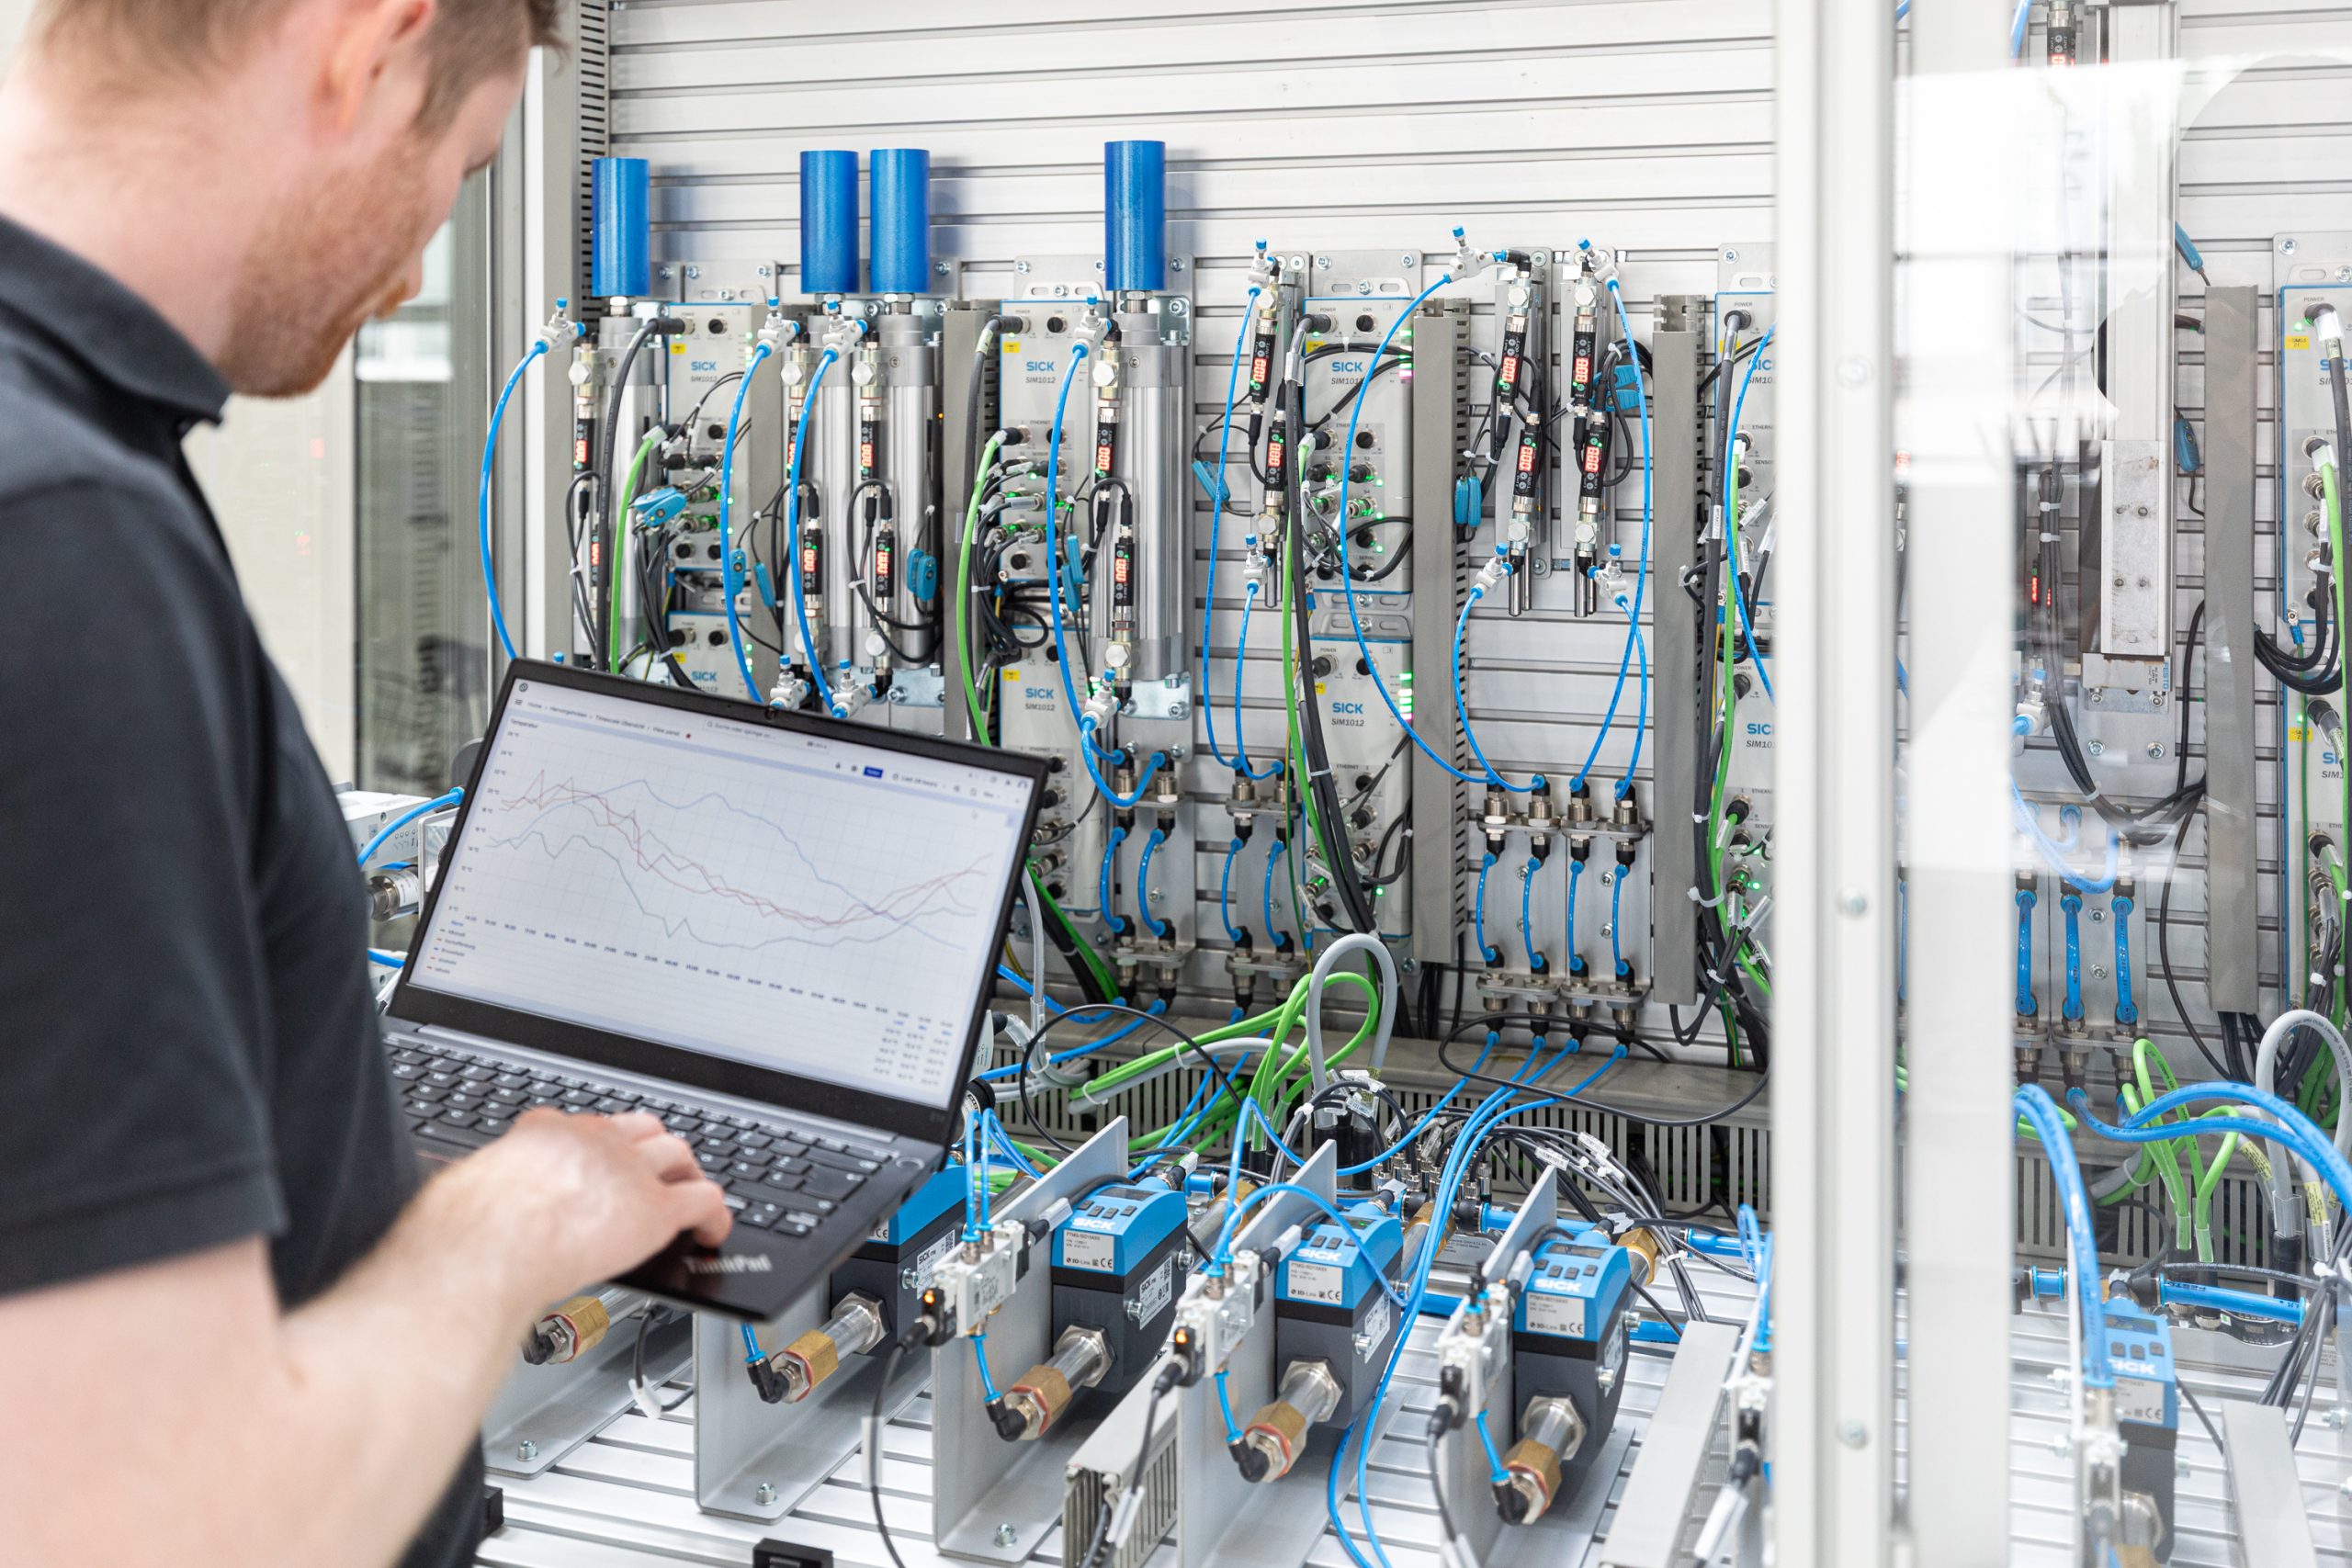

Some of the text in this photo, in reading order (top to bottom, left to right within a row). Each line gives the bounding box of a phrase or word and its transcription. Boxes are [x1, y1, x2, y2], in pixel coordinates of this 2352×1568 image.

[691, 361, 716, 371] SICK
[1026, 361, 1055, 372] SICK
[1332, 362, 1363, 372] SICK
[1748, 359, 1773, 371] SIC
[691, 671, 716, 681] SICK
[1026, 688, 1054, 699] SICK
[1025, 703, 1055, 711] SIM1012
[1332, 703, 1363, 714] SICK
[1331, 718, 1365, 727] SIM1012
[1747, 723, 1775, 735] SIC
[1746, 740, 1775, 748] SIM10
[2323, 752, 2340, 765] SI
[2322, 770, 2343, 779] SIM1
[1072, 1218, 1116, 1230] SICK
[919, 1250, 930, 1264] SICK
[1296, 1248, 1341, 1262] SICK
[1100, 1258, 1112, 1269] CE
[1534, 1278, 1582, 1292] SICK
[1328, 1290, 1341, 1301] CE
[1569, 1322, 1583, 1334] CE
